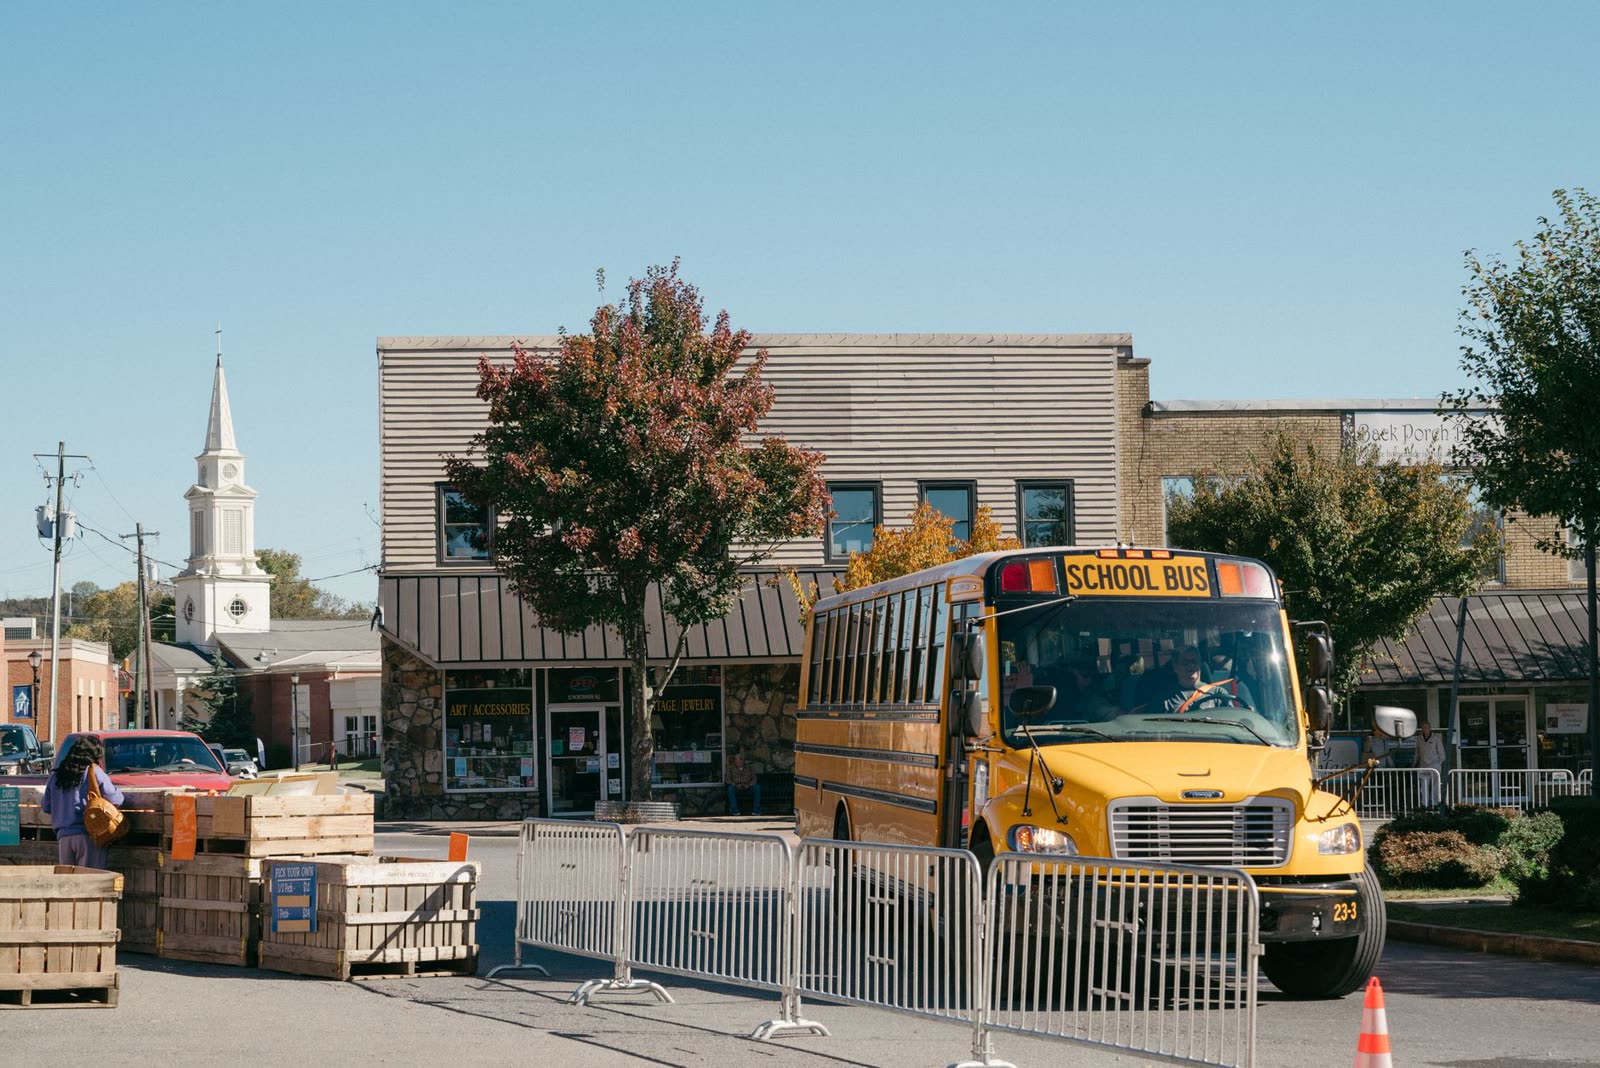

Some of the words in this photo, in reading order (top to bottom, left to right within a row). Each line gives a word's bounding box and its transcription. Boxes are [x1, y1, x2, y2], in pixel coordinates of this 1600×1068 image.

[1358, 423, 1398, 443] Back
[1402, 423, 1449, 444] Porch
[1067, 564, 1159, 590] SCHOOL
[1163, 565, 1208, 591] BUS
[450, 704, 467, 716] ART
[473, 703, 531, 716] ACCESSORIES
[654, 699, 677, 711] TAGE
[681, 698, 715, 714] JEWELRY
[275, 867, 286, 878] PICK
[287, 867, 300, 878] YOUR
[301, 866, 314, 877] OWN
[1333, 901, 1357, 921] 23-3
